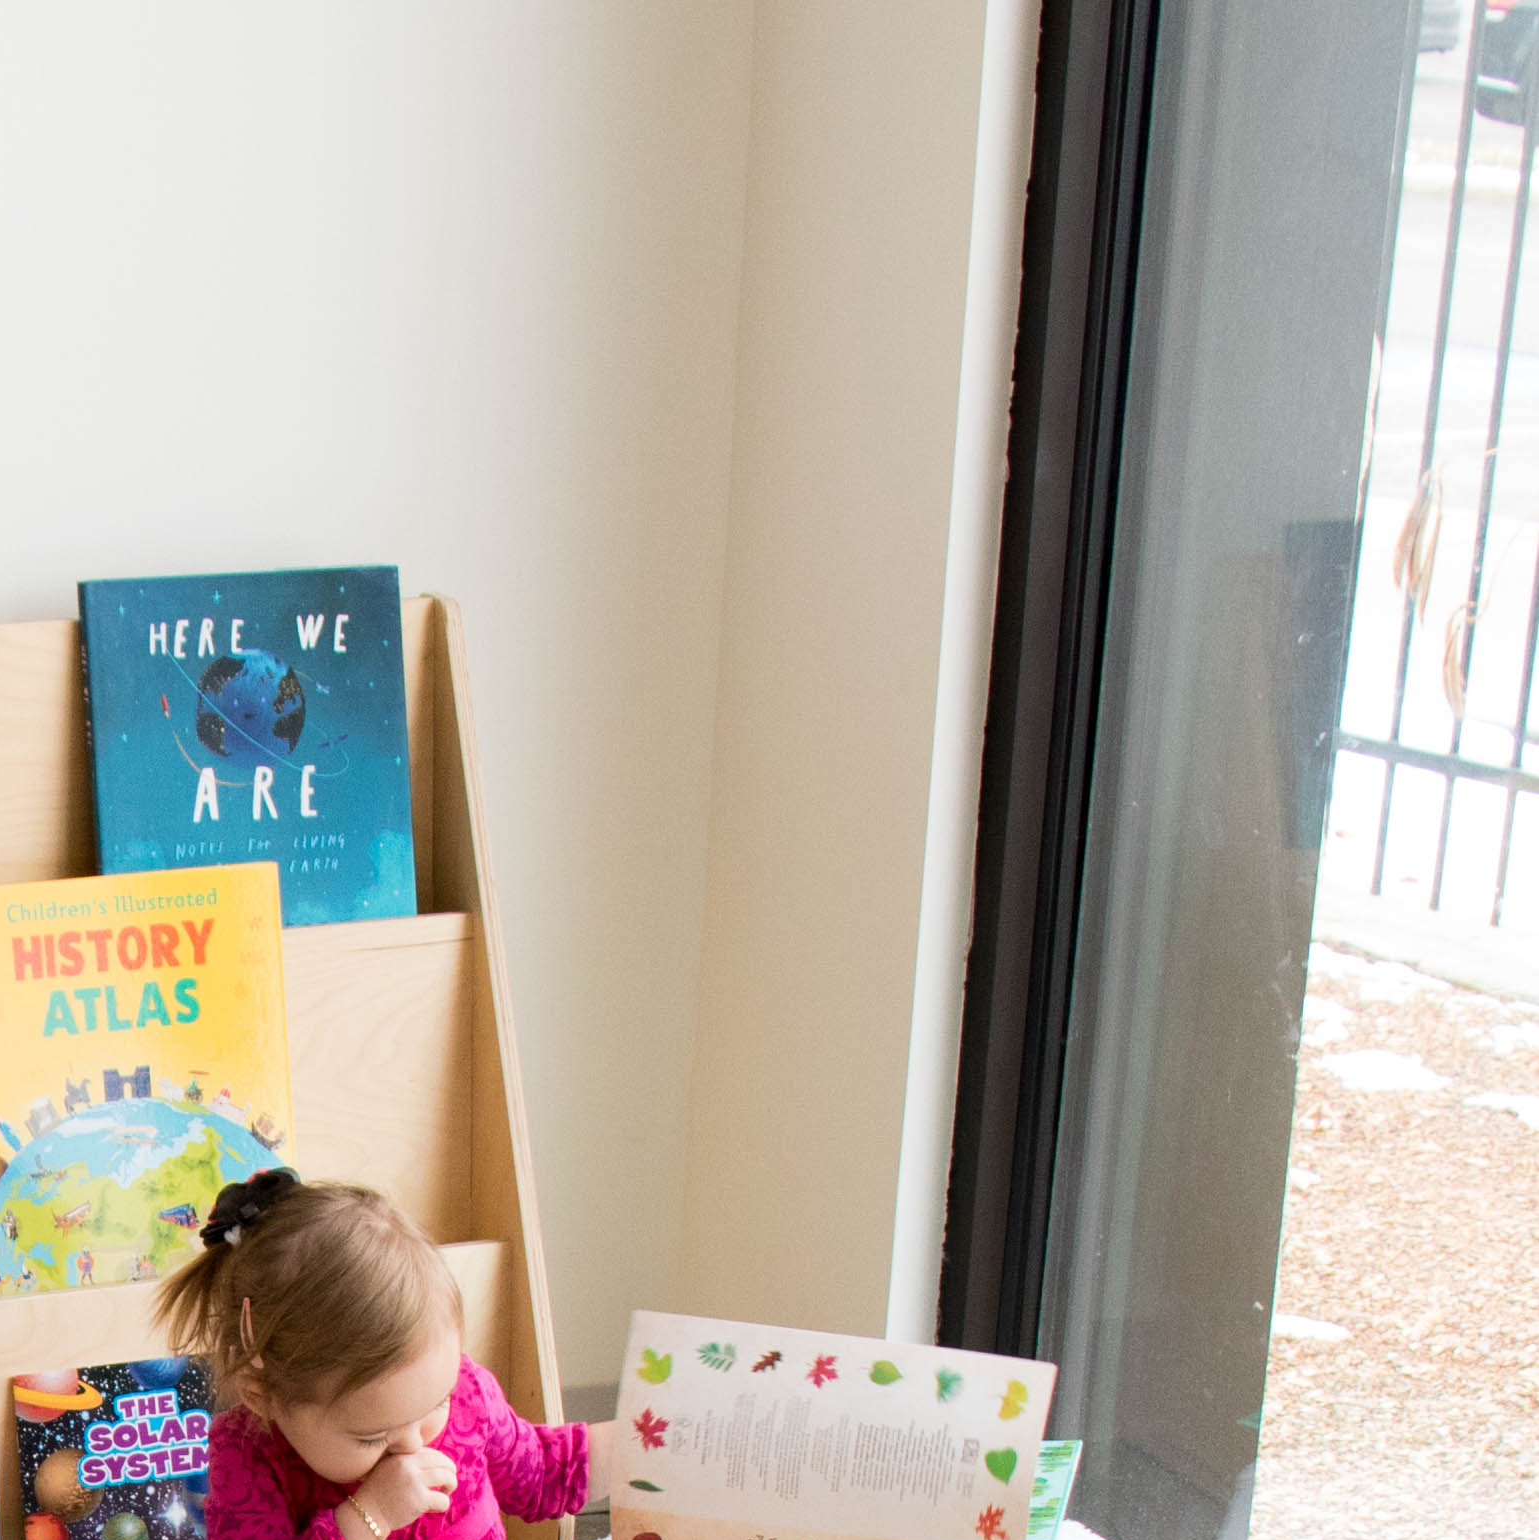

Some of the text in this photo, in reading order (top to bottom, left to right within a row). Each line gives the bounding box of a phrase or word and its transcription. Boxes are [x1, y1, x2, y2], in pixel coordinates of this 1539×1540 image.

[149, 614, 349, 657] HERE WE
[193, 765, 318, 823] ARE
[176, 842, 223, 860] NOTES
[293, 833, 344, 848] LIVING
[290, 857, 338, 872] EARTH
[6, 888, 218, 923] Children's Illustrated
[12, 918, 215, 981] HISTORY
[42, 978, 200, 1038] ATLAS
[119, 1394, 175, 1418] THE
[89, 1414, 210, 1452] SOLAR
